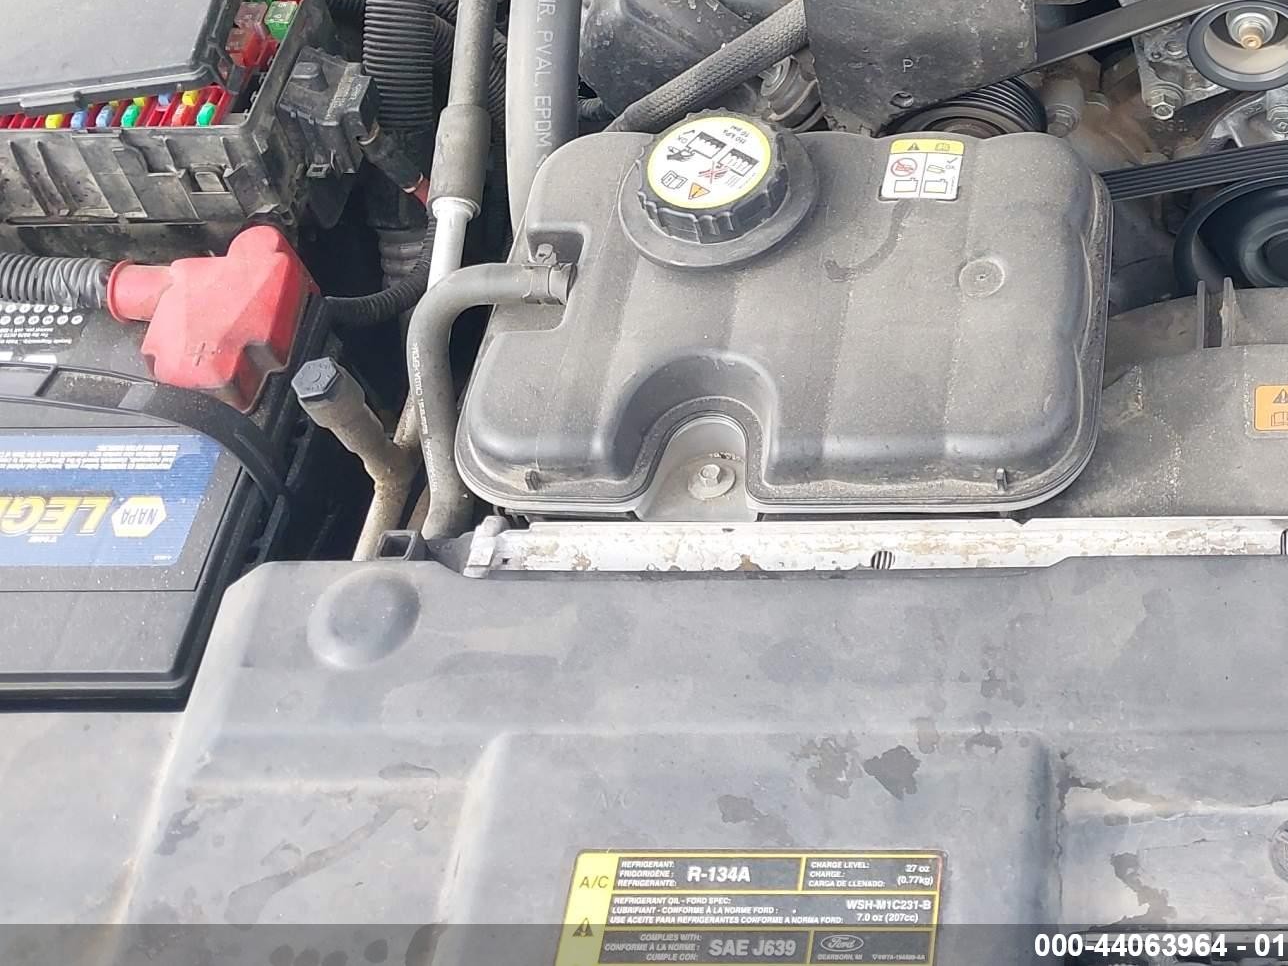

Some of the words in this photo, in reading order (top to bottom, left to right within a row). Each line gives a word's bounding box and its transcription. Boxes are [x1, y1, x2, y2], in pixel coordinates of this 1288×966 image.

[533, 95, 554, 148] EPDM
[0, 495, 115, 537] LEG
[121, 507, 157, 525] NAPA
[686, 865, 751, 883] R-134A
[905, 864, 917, 873] 27
[918, 865, 930, 873] oz
[579, 875, 609, 889] A/C
[896, 875, 934, 886] (0.77kg)
[667, 896, 680, 905] OIL
[845, 899, 932, 910] WSH-M1C231-B
[611, 906, 656, 914] LUBRIFIANT
[661, 906, 705, 914] CONFORME
[713, 906, 723, 914] LA
[724, 906, 751, 914] NORME
[752, 906, 774, 914] FORD
[609, 916, 626, 924] USE
[626, 916, 654, 924] ACEITE
[655, 916, 676, 924] PARA
[676, 916, 740, 924] REFRIGERANTES
[740, 916, 783, 924] CONFORME
[791, 916, 819, 924] NORMA
[857, 912, 870, 922] 7.0
[871, 914, 884, 922] oz
[884, 913, 919, 924] (207cc)
[604, 943, 647, 951] CONFORME
[655, 943, 667, 951] LA
[667, 943, 696, 951] NORME
[708, 939, 750, 956] SAE
[752, 939, 797, 957] J639
[645, 953, 677, 961] CUMPLE
